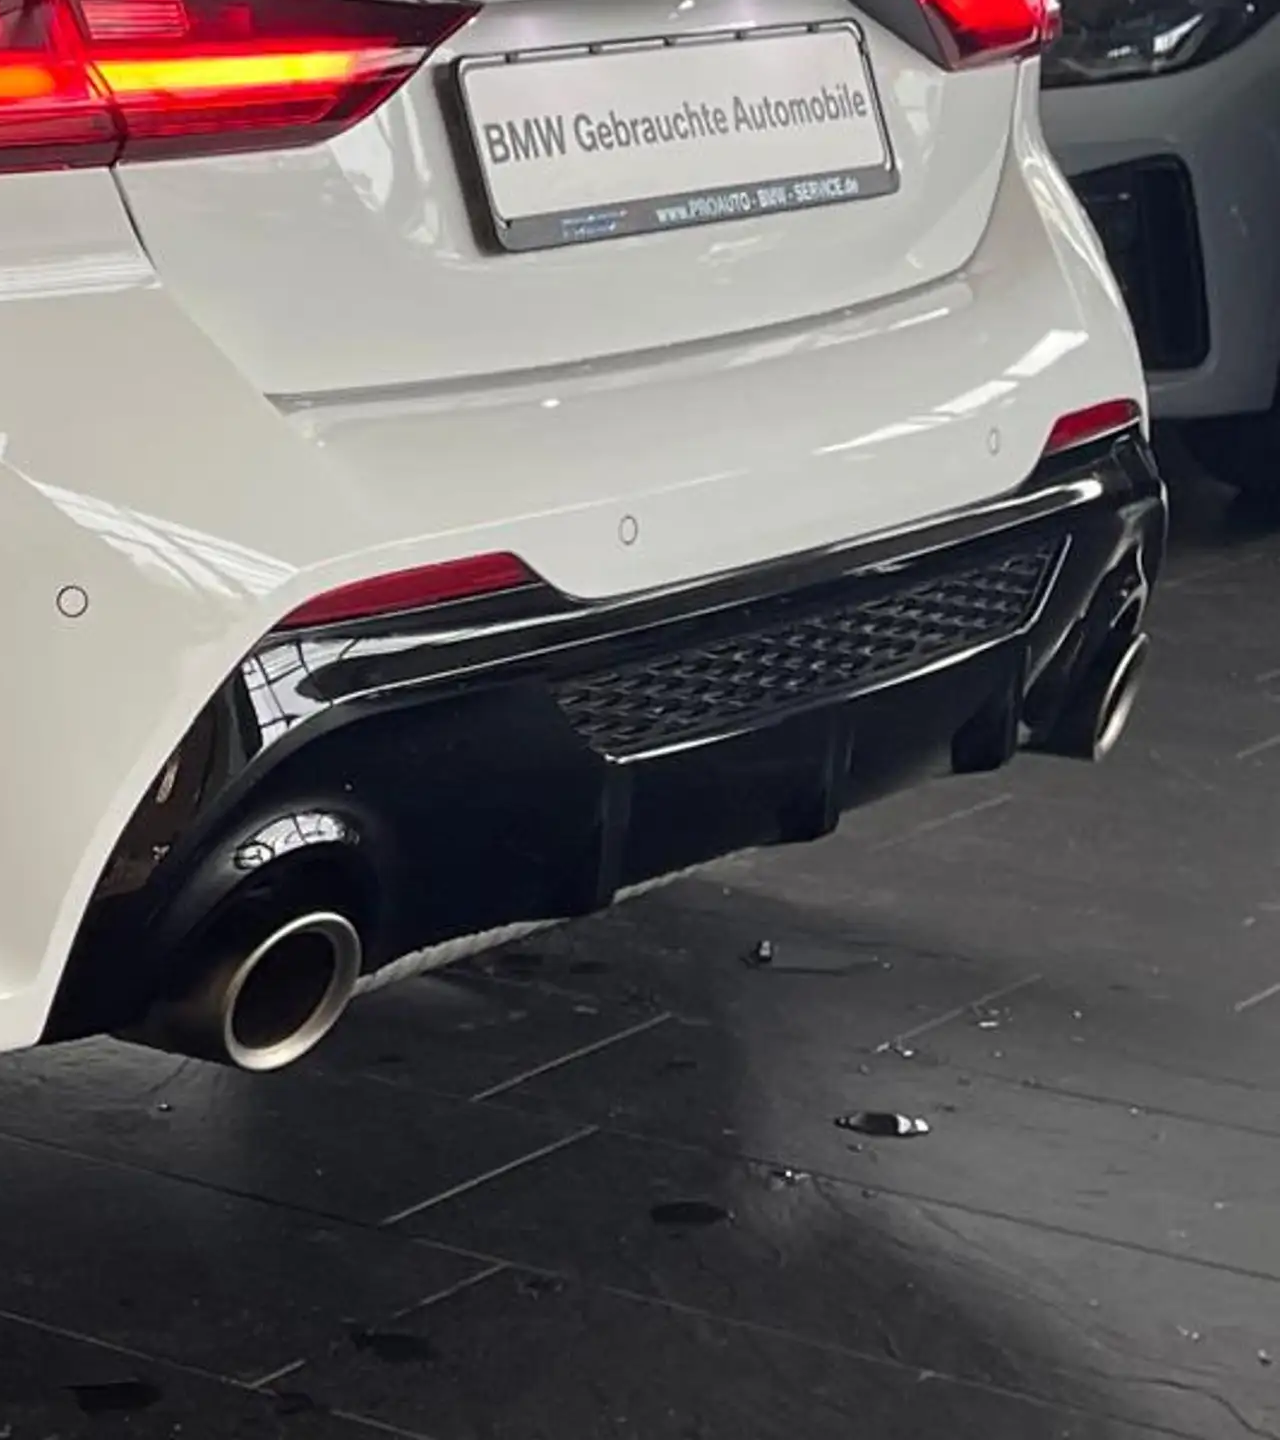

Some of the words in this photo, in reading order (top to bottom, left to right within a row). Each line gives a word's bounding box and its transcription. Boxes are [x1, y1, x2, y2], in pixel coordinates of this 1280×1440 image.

[483, 114, 566, 165] BMW
[573, 100, 730, 152] Gebrauchte
[732, 83, 867, 133] Automobile
